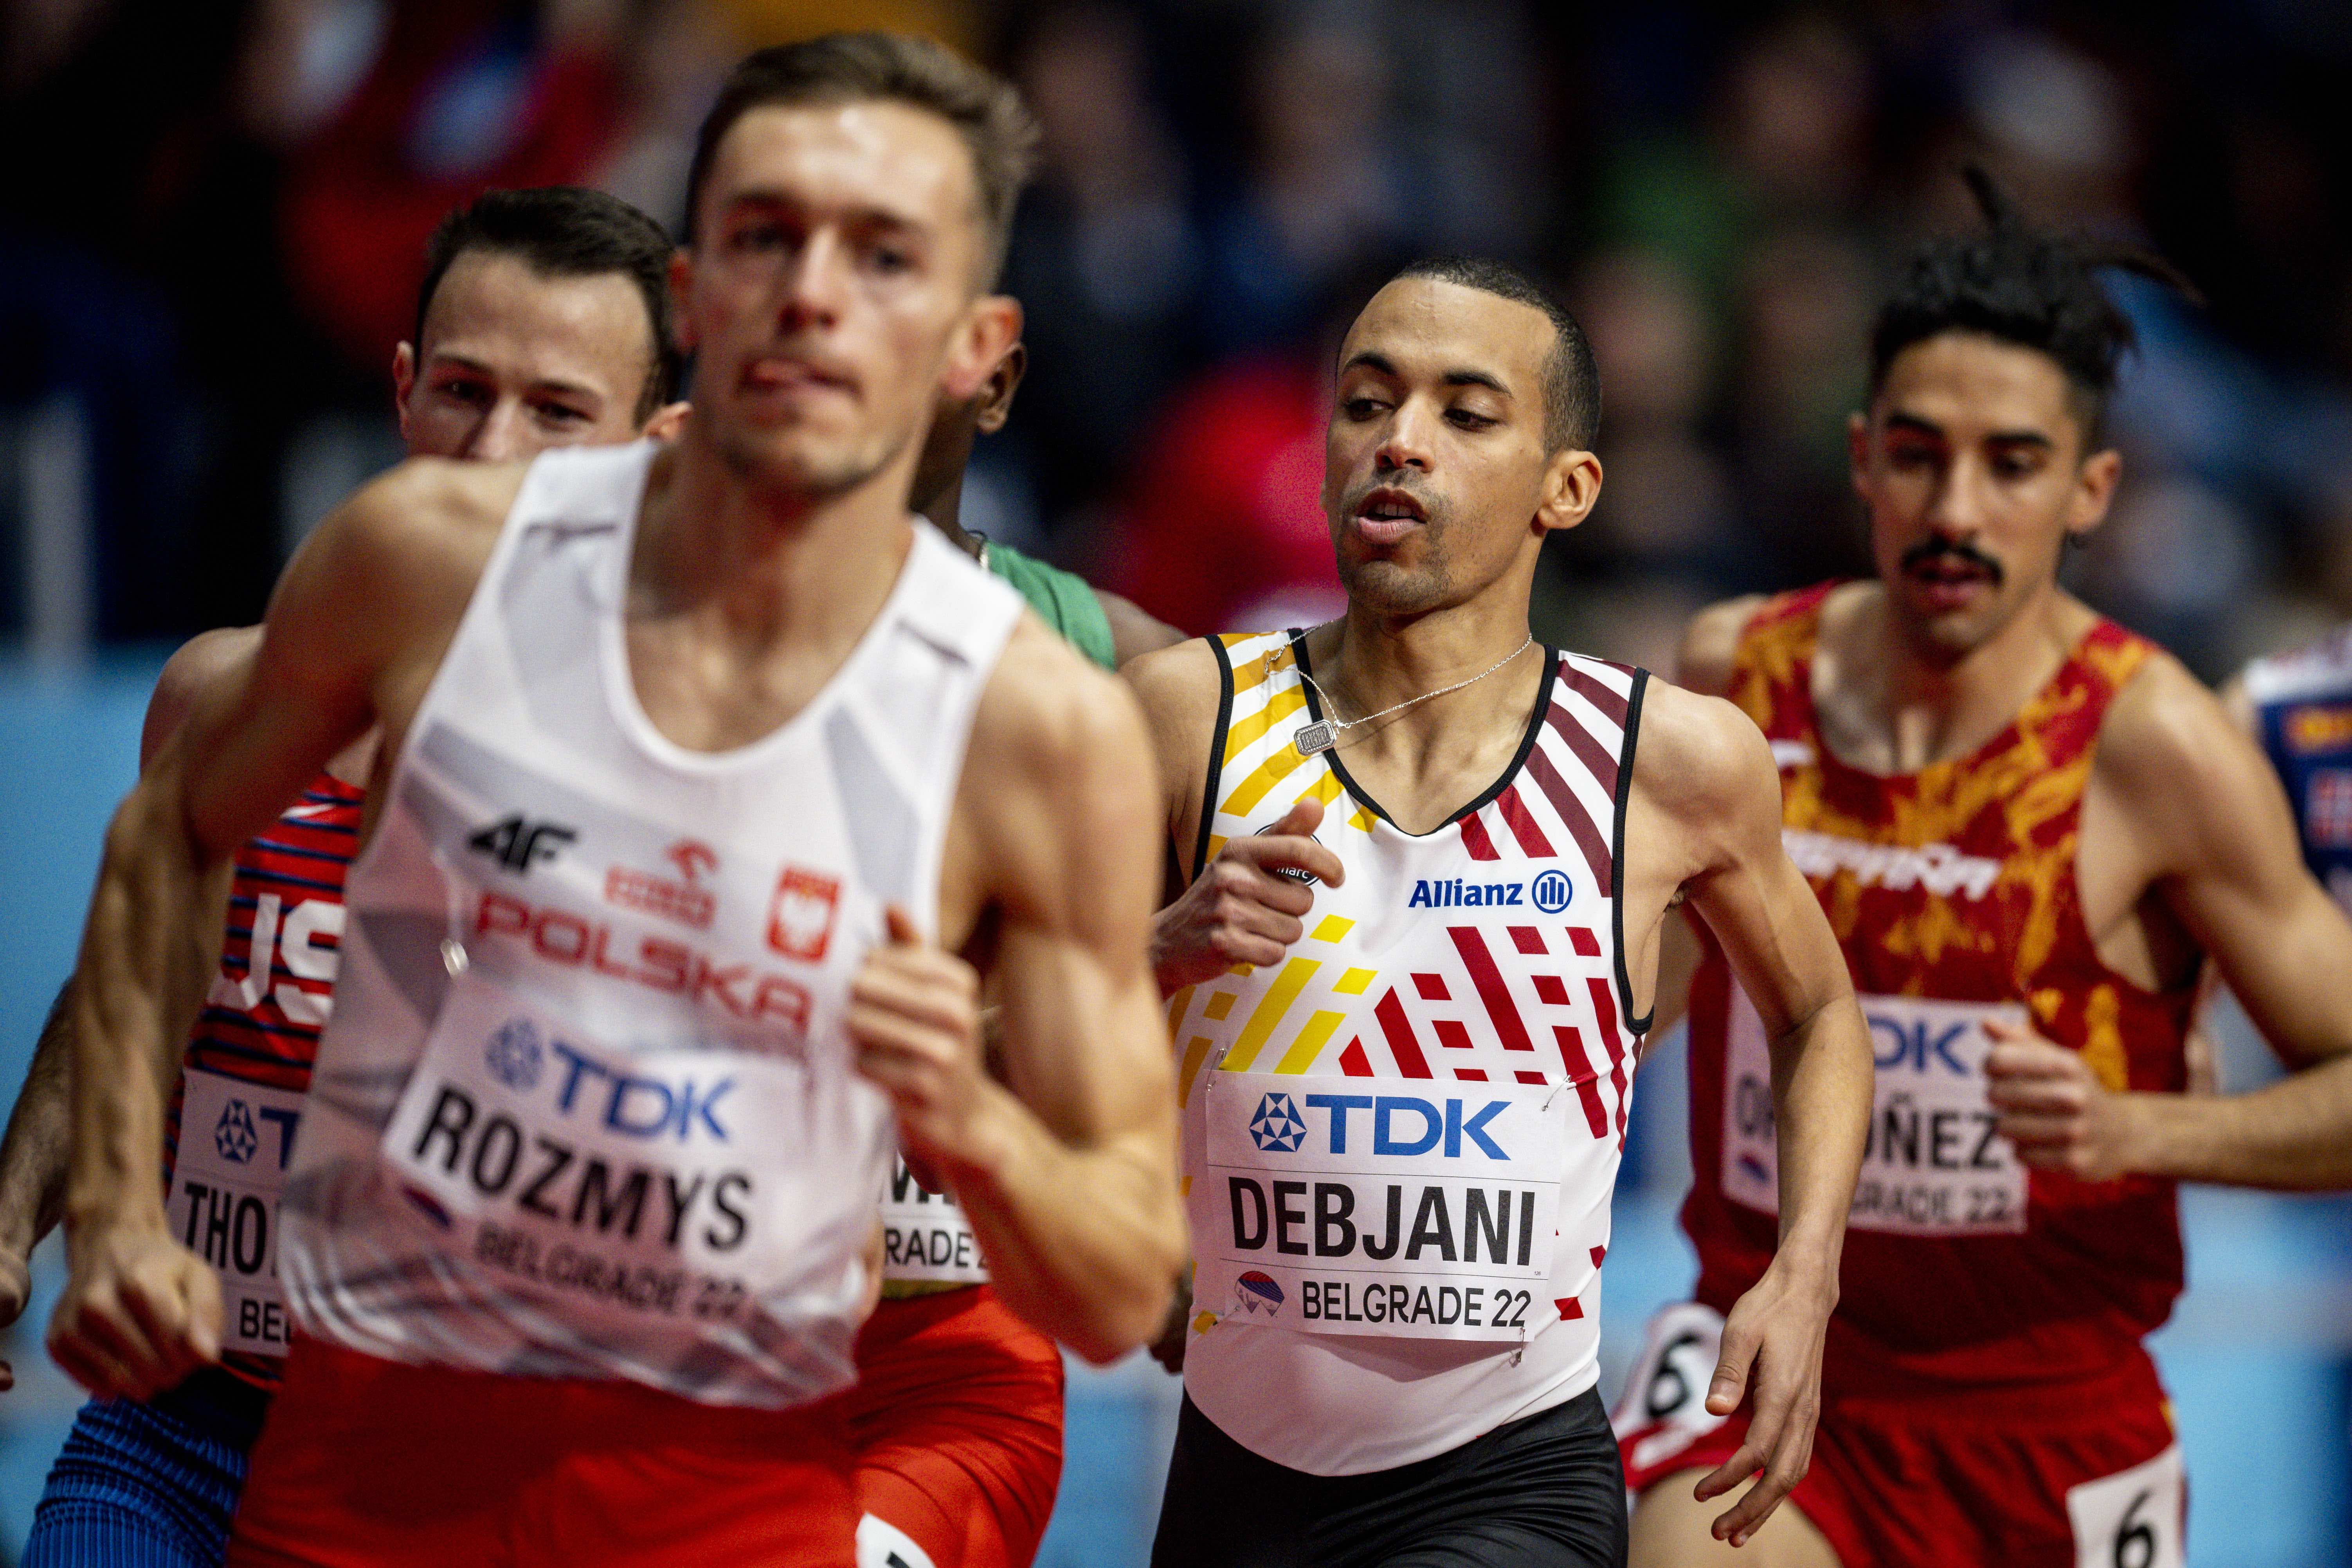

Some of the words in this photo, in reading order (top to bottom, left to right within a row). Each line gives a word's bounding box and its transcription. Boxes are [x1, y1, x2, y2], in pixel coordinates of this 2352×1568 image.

[1408, 879, 1523, 909] Allianz
[476, 889, 812, 1037] POLSKA
[553, 1039, 738, 1146] TDK
[1306, 1093, 1512, 1161] TDK
[414, 1085, 754, 1252] ROZMYS
[185, 1180, 279, 1276] THO
[1228, 1176, 1536, 1267] DEBJANI
[1303, 1280, 1484, 1327] BELGRADE
[1491, 1289, 1531, 1327] 22
[1645, 1327, 1703, 1419] 6
[2112, 1485, 2156, 1568] 6
